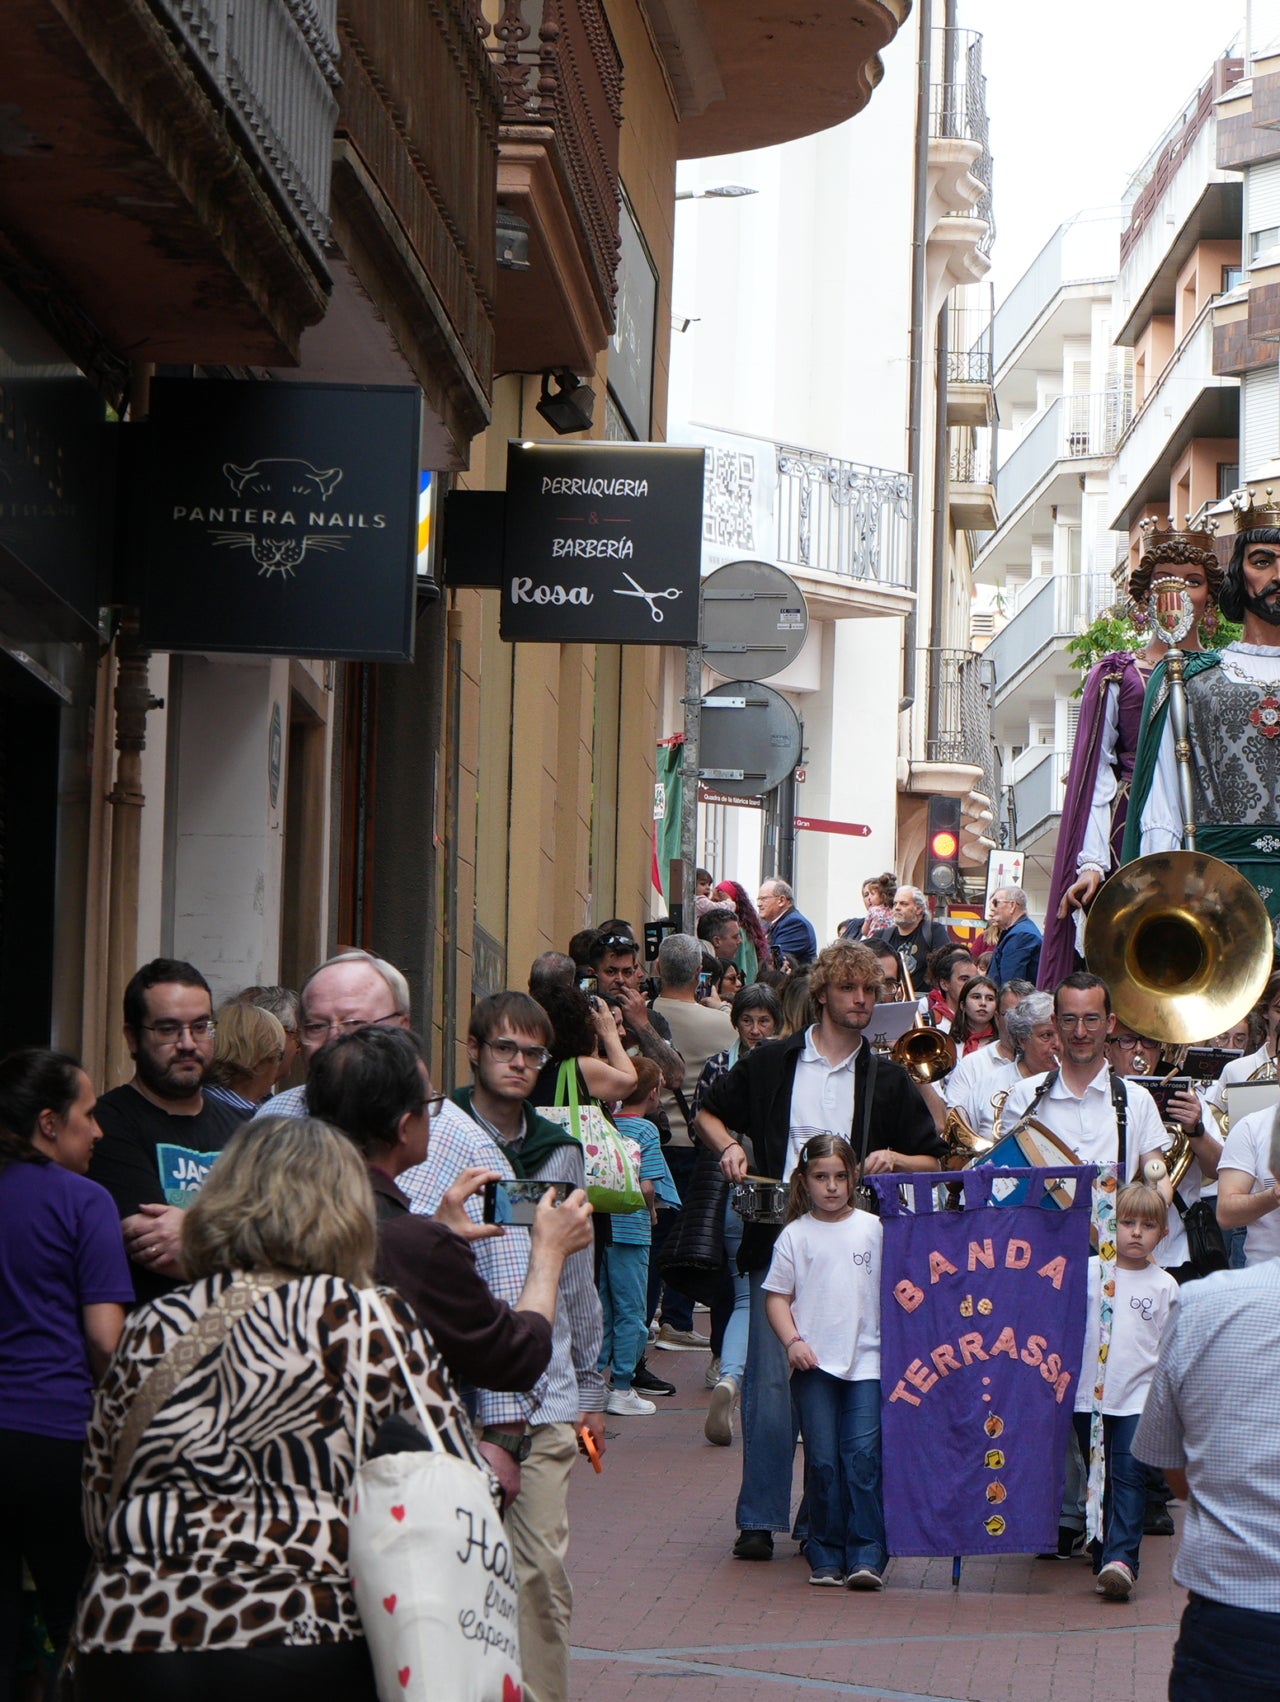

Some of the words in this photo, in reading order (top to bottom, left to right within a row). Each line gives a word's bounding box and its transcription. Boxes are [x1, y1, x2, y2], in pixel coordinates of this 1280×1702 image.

[541, 476, 649, 498] PERRUQUERIA
[173, 505, 297, 525] PANTERA
[308, 511, 387, 529] NAILS
[588, 511, 600, 525] &
[551, 535, 634, 559] BARBERÍA
[511, 576, 595, 606] Rosa
[892, 1238, 1068, 1314] BANDA
[959, 1294, 994, 1318] de
[888, 1326, 1073, 1408] TERRASSA
